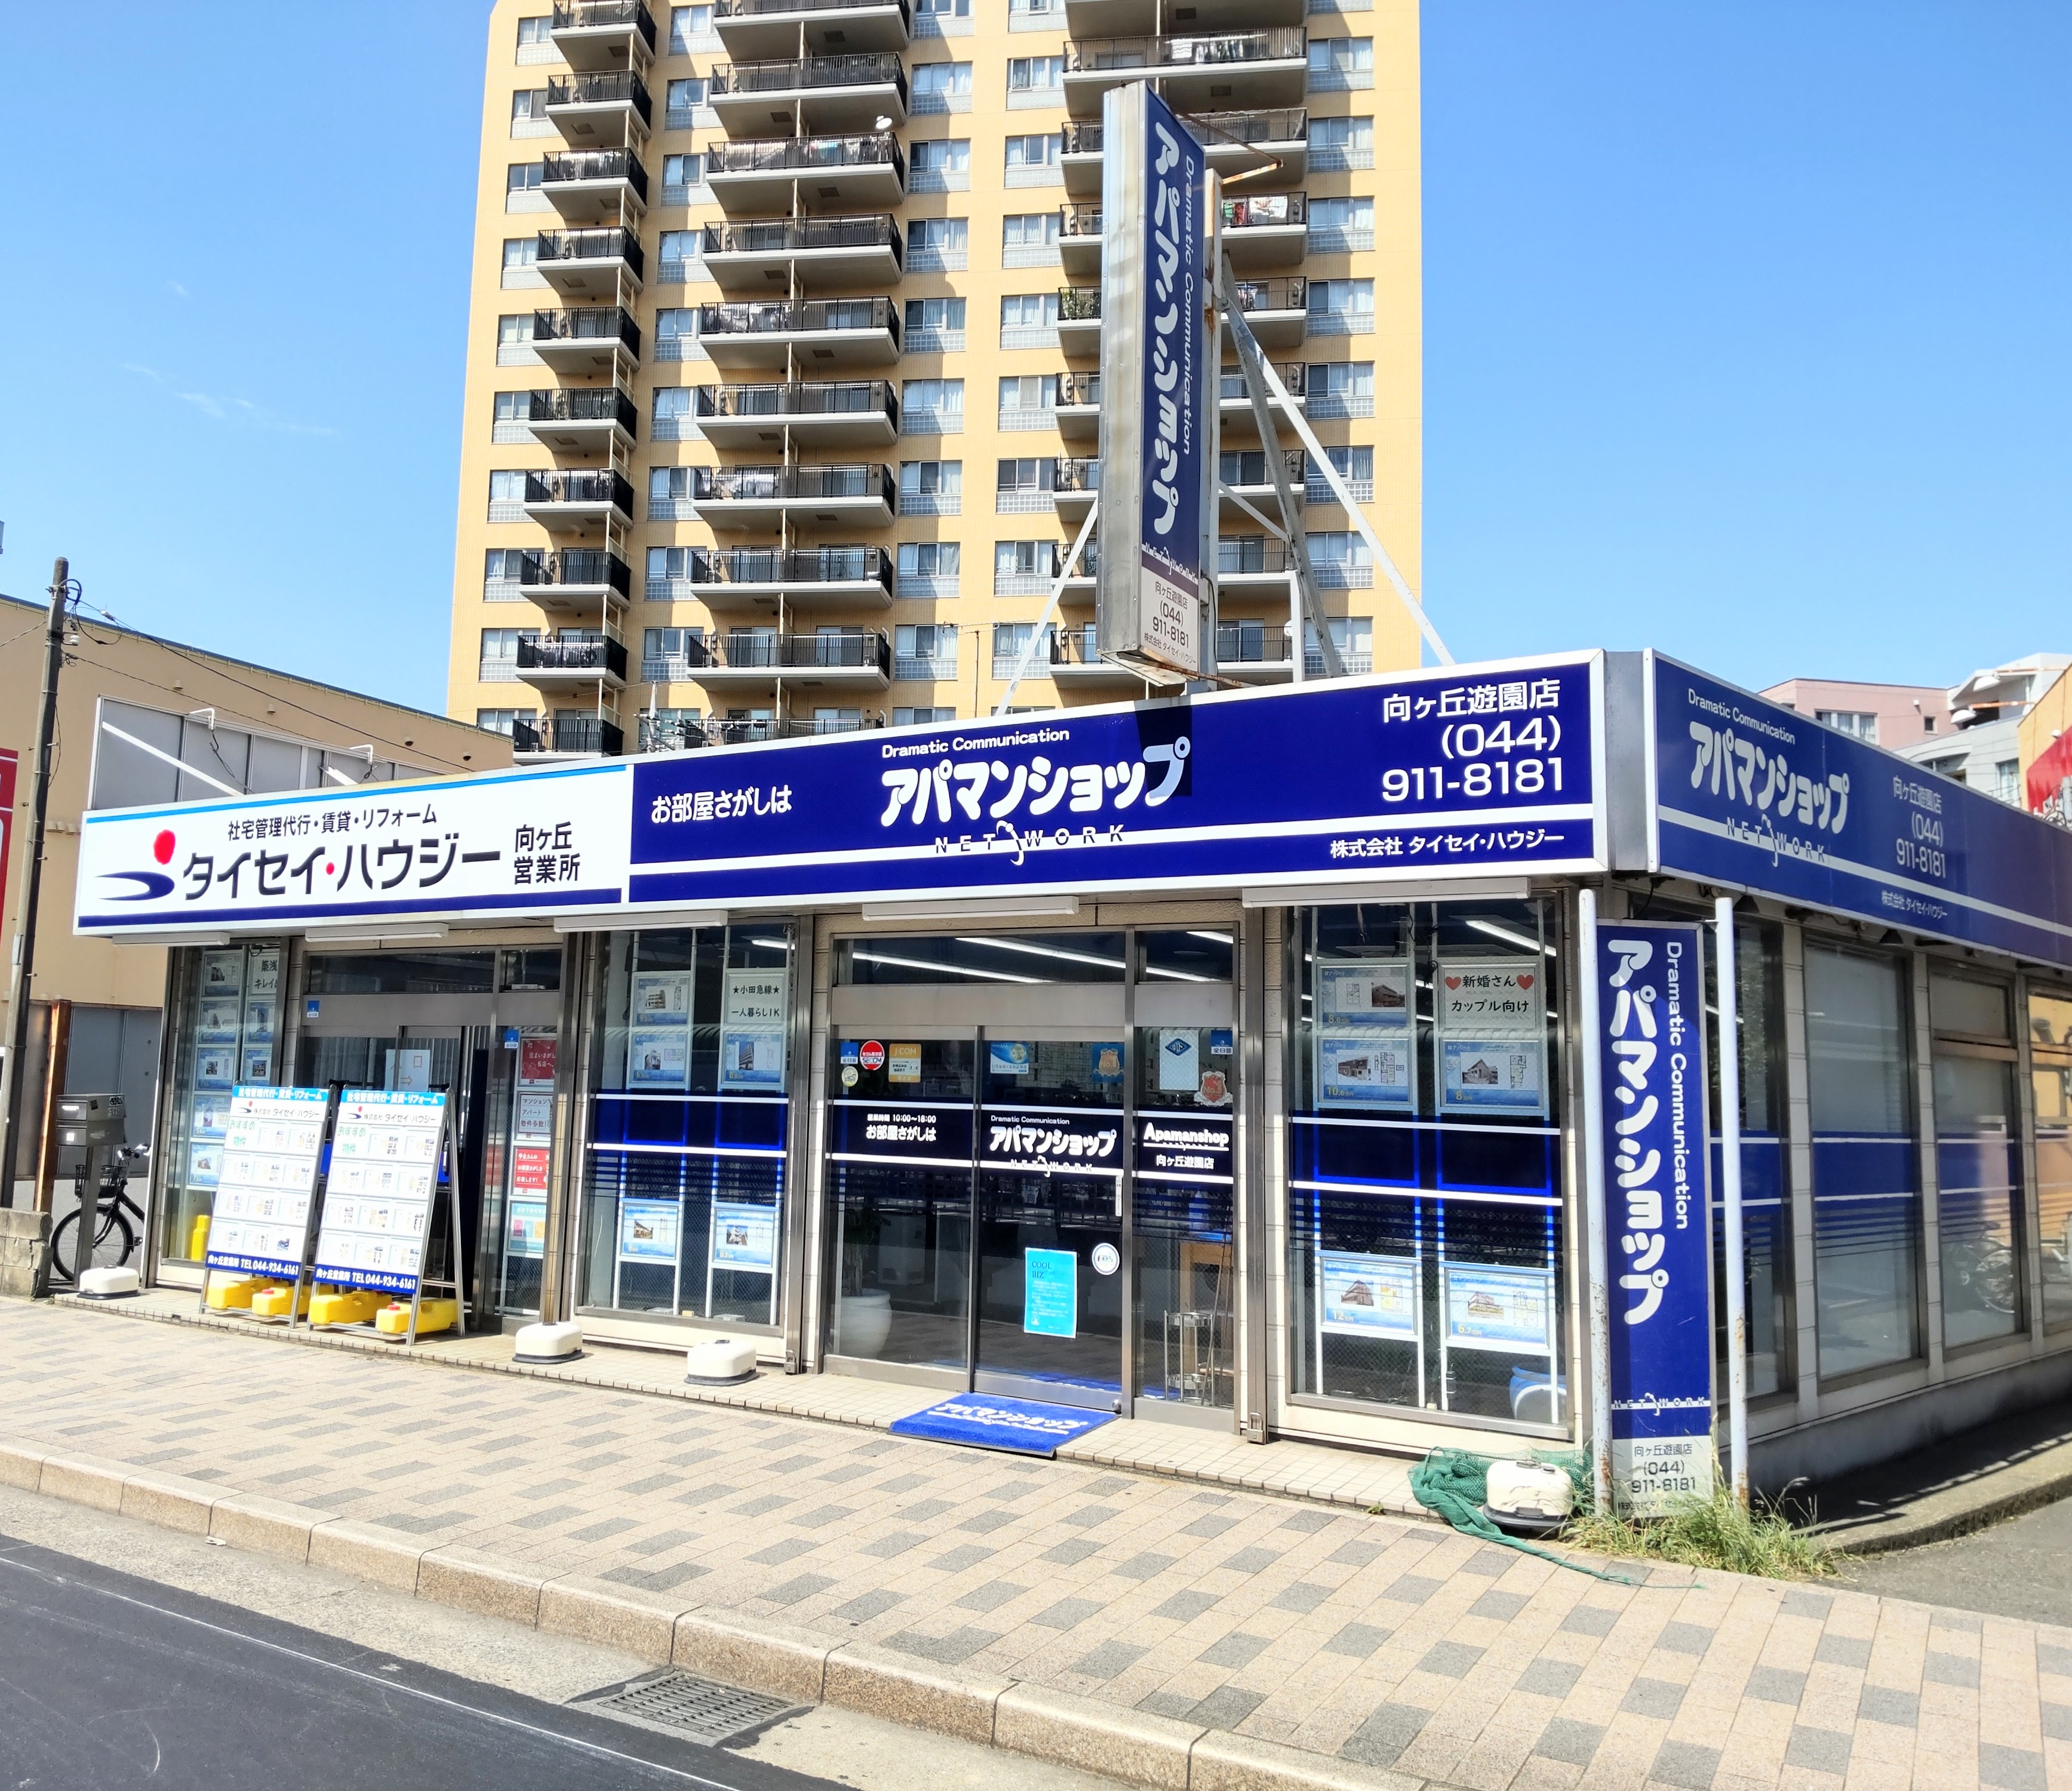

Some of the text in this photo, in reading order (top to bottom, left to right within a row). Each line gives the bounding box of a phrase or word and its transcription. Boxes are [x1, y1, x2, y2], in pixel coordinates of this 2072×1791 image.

[1183, 155, 1194, 456] Dramatic Communication
[1152, 122, 1180, 535] アパマンショップ
[1155, 581, 1188, 611] 向ヶ丘遊園店
[1160, 600, 1183, 627] (044)
[1144, 633, 1163, 650] 株式会社
[1153, 616, 1189, 648] 911-8181
[1384, 678, 1561, 723] 向ヶ丘遊園店
[1688, 688, 1796, 745] Dramatic Communication
[882, 728, 1071, 759] Dramatic Communication
[1441, 715, 1562, 759] (044)
[881, 736, 1192, 827] アパマンショップ
[1382, 756, 1563, 802] 911-8181
[1689, 721, 1850, 835] アパマンショップ
[650, 785, 793, 824] お部屋さがしは
[1893, 775, 1942, 816] 向ヶ丘遊園店
[228, 803, 438, 842] 社宅管理代行・賃貸・リフォーム
[514, 822, 573, 852] 向ヶ丘
[1911, 811, 1944, 848] (044)
[1330, 829, 1564, 858] 株式会社 タイセイ・ハウジー
[1896, 838, 1947, 879] 911-8181
[183, 833, 501, 901] タイセイ・ハウジー
[512, 852, 581, 885] 営業所
[1881, 890, 1905, 911] 株式会社
[1462, 974, 1516, 988] 新婚さん
[1451, 998, 1529, 1013] カップル向け
[1667, 941, 1692, 1230] Dramatic Communication
[229, 1119, 255, 1131] おすすめ
[337, 1126, 366, 1137] おすすめ
[866, 1124, 937, 1142] お部屋さがしは
[991, 1115, 1070, 1125] Dramatic Communication
[1143, 1122, 1230, 1147] Apamanshop
[1608, 939, 1670, 1325] アパマンショップ
[989, 1124, 1118, 1158] アパマンショップ
[1156, 1154, 1215, 1170] 向ヶ丘遊園店
[241, 1258, 252, 1270] TEL
[253, 1260, 299, 1276] 044-934-6161
[1032, 1260, 1052, 1269] COOL
[1032, 1270, 1044, 1279] BIZ
[352, 1272, 365, 1284] TEL
[365, 1273, 416, 1290] 044-934-6161
[935, 1403, 1089, 1430] アパマンショップ
[1634, 1444, 1693, 1457] 向ヶ丘遊園店
[1643, 1460, 1685, 1476] (044)
[1631, 1477, 1696, 1493] 911-8181
